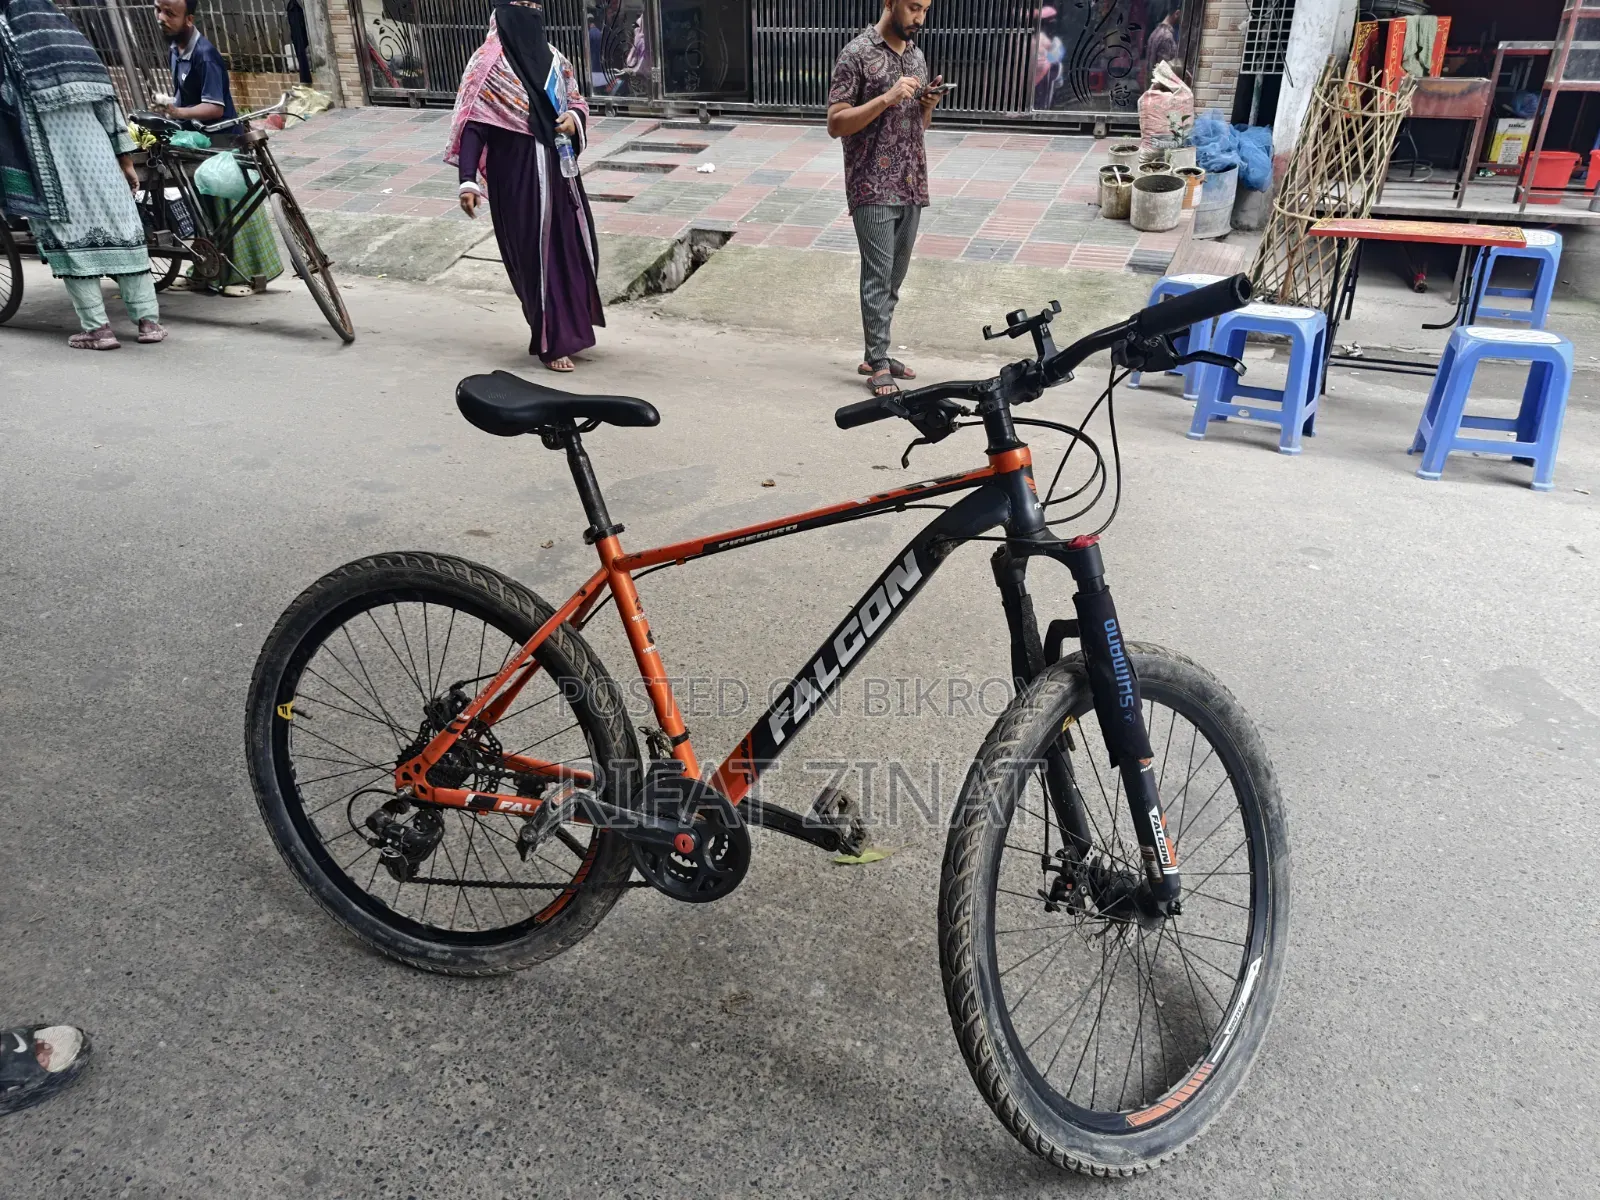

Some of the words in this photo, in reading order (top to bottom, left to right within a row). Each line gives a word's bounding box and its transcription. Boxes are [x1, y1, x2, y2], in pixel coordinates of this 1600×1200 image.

[768, 548, 923, 746] FALCON
[1104, 618, 1134, 708] SHIMANO
[1151, 814, 1170, 864] FALCON
